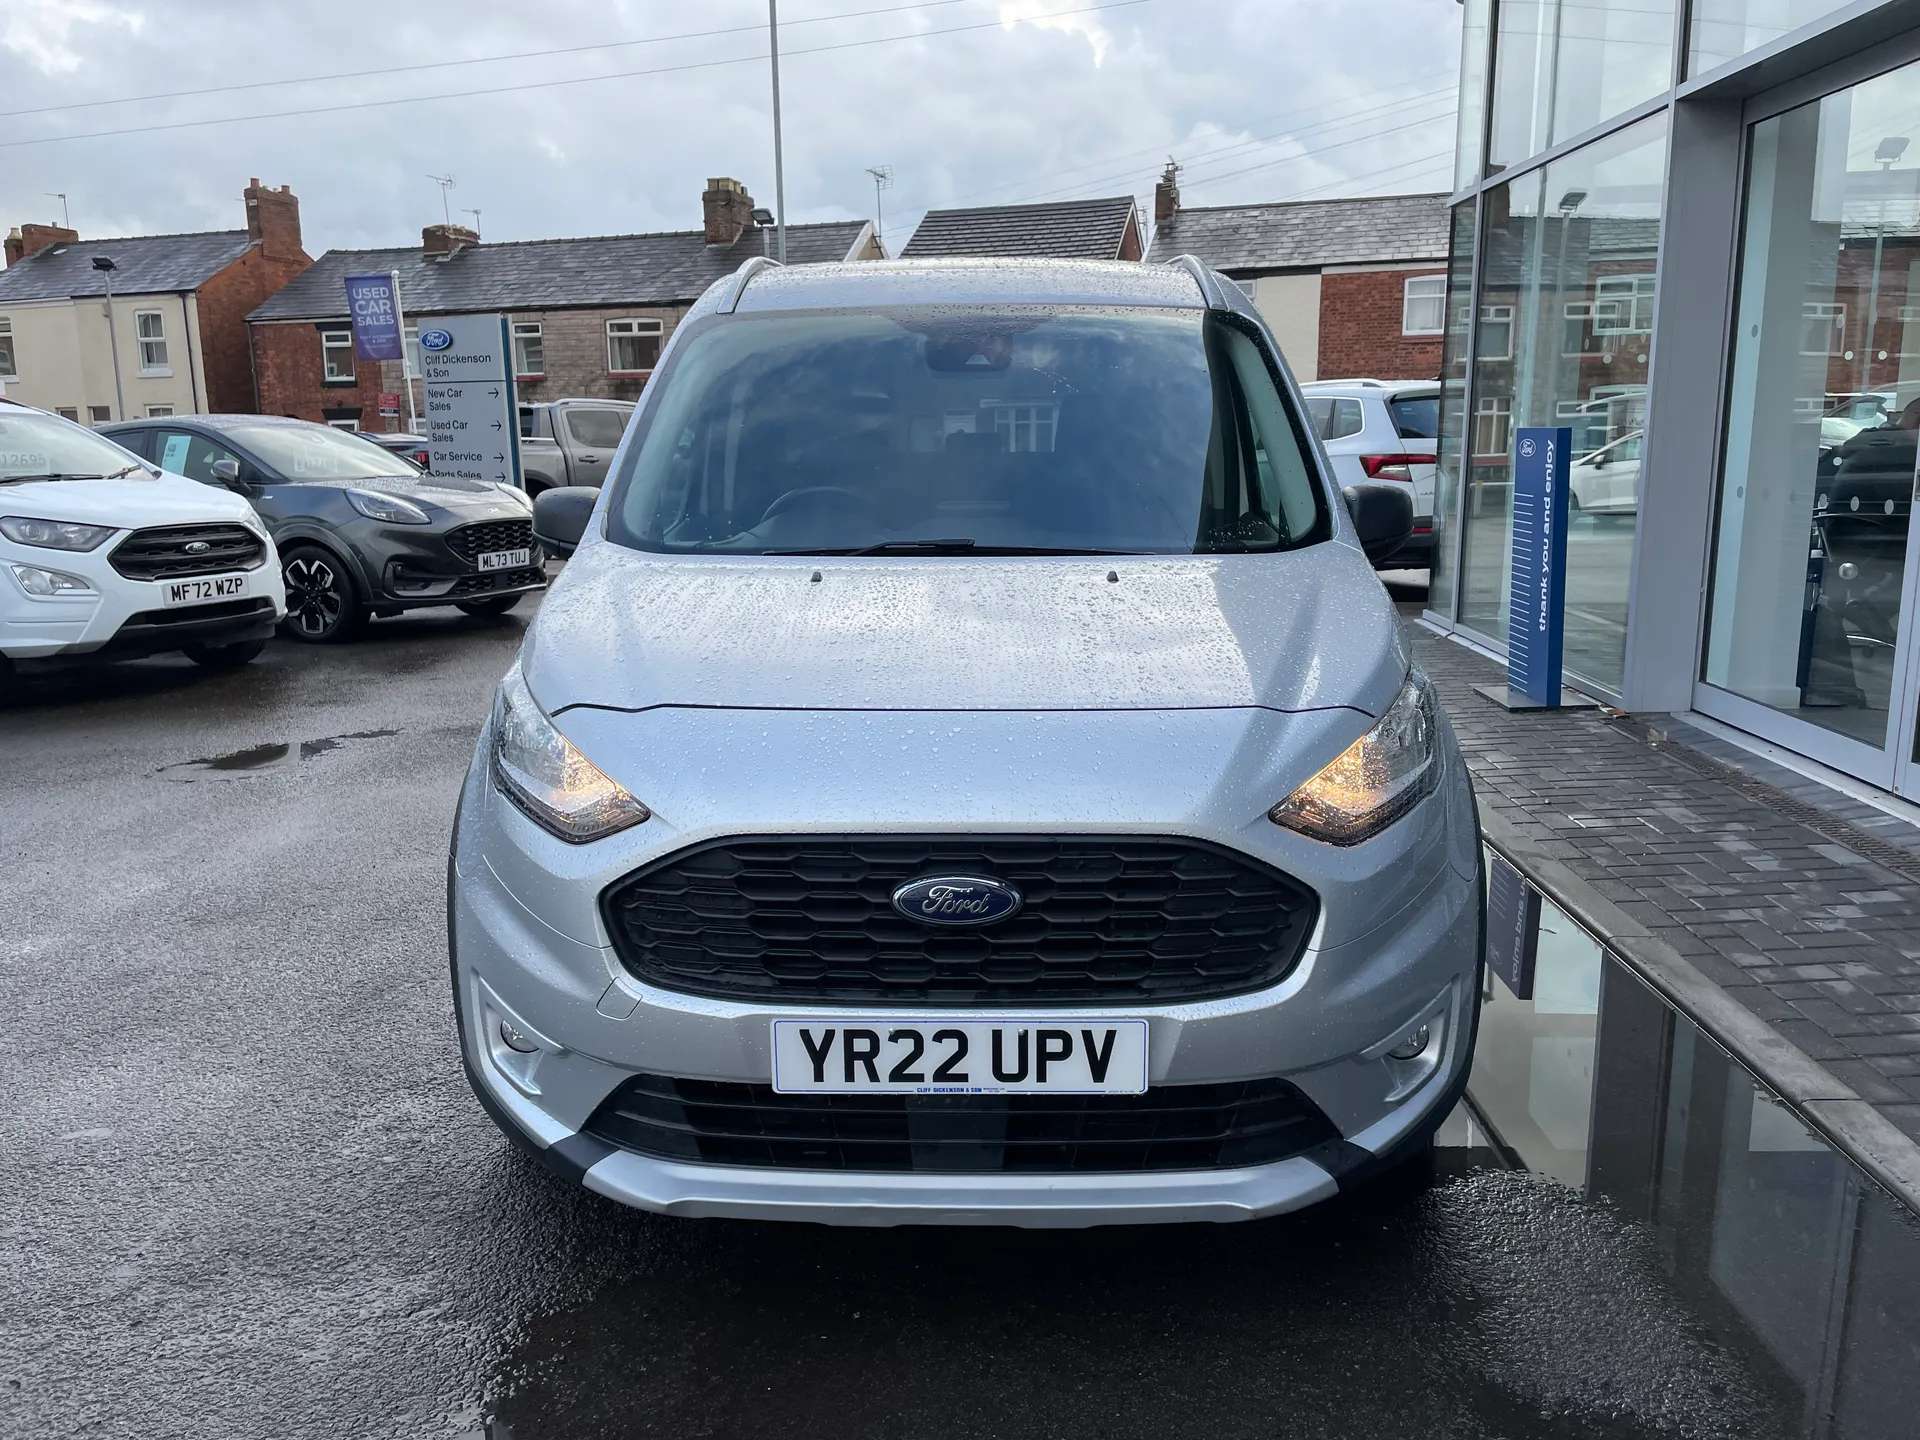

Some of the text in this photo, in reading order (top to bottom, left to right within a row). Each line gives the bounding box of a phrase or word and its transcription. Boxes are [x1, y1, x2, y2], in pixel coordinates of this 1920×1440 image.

[353, 287, 389, 299] USED
[355, 300, 391, 314] CAR
[357, 315, 394, 326] SALES
[425, 354, 491, 366] Cliff Dickenson
[426, 368, 449, 377] & Son
[428, 388, 462, 398] New Car
[429, 401, 451, 411] Sales
[430, 420, 468, 430] Used Car
[432, 432, 454, 442] Sales
[433, 451, 483, 461] Car Service
[1545, 439, 1554, 493] enjoy
[1543, 496, 1551, 535] and
[482, 551, 526, 569] ML73 TUJ
[170, 577, 243, 602] MF72 WZP
[1539, 576, 1548, 632] thank
[921, 885, 991, 914] Ford
[799, 1029, 1117, 1083] YR22 UPV
